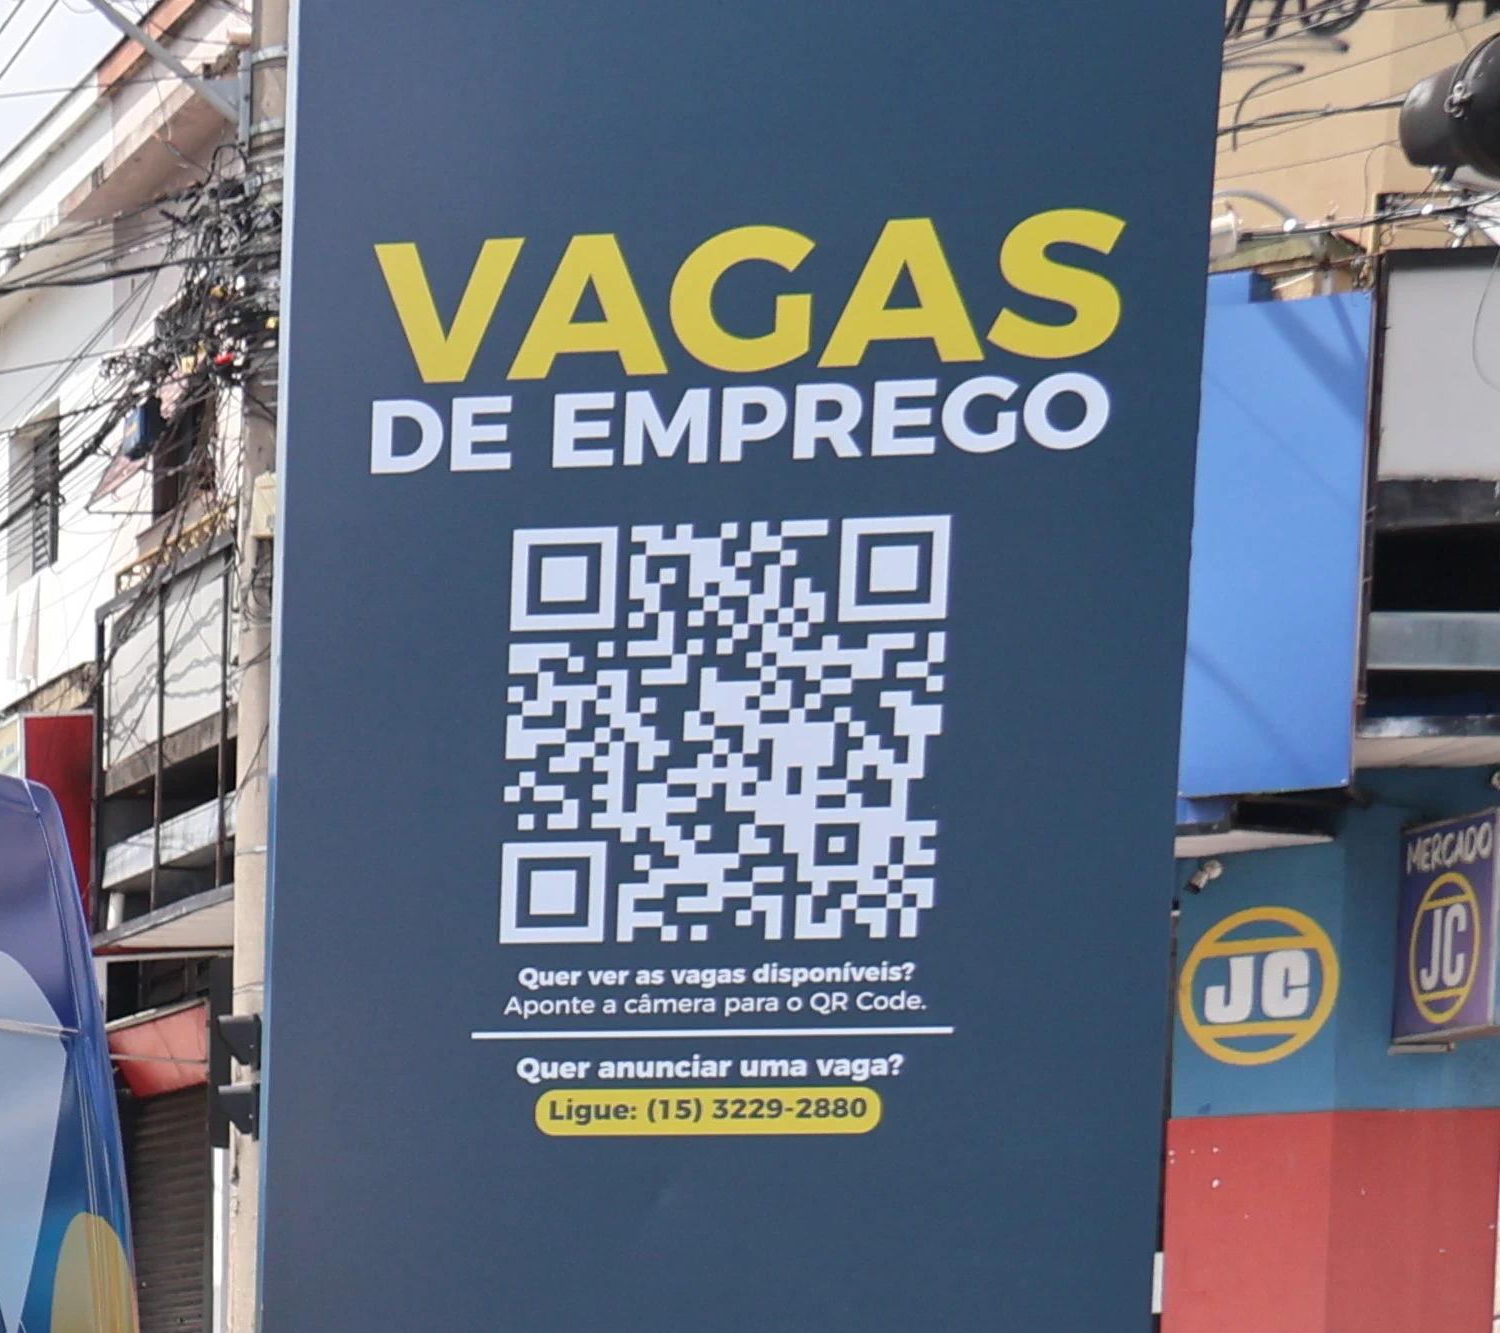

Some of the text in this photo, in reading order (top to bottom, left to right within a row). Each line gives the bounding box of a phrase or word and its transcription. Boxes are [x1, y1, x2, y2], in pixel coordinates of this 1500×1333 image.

[373, 207, 1127, 384] VAGAS
[370, 371, 1112, 474] DE EMPREGO
[1407, 821, 1493, 875] MERCADO
[1420, 903, 1467, 992] JC
[518, 962, 915, 990] Quer ver as vagas disponíveis?
[1204, 949, 1310, 1024] JC
[504, 991, 927, 1020] Aponte a câmera para o QR Code.
[516, 1053, 904, 1082] Quer anunciar uma vaga?
[549, 1096, 867, 1125] Ligue: (15) 3229-2880
